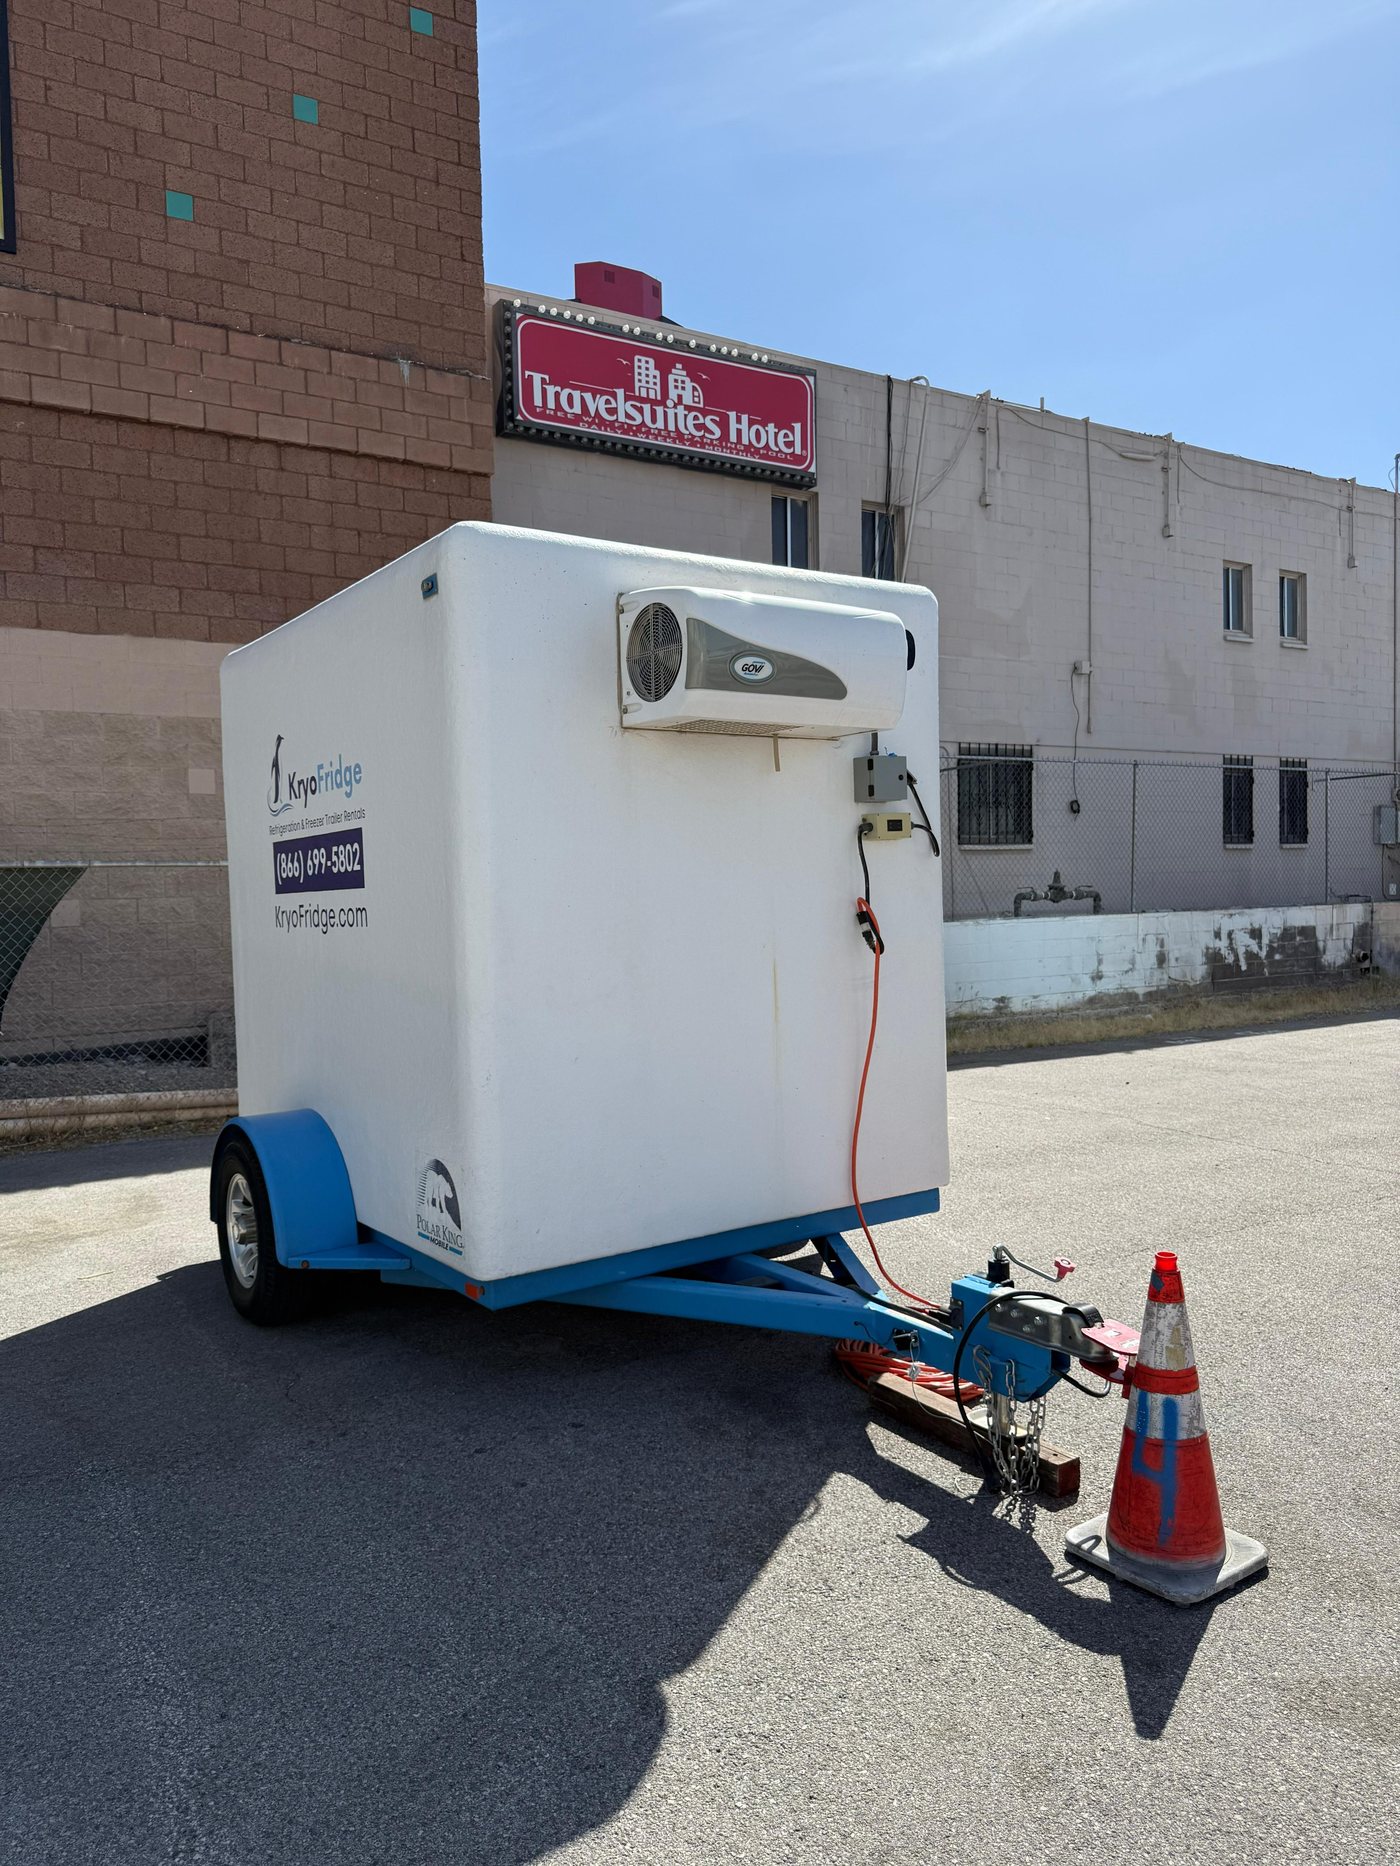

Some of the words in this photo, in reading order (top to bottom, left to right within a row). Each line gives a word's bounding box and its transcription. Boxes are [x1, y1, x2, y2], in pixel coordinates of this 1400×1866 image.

[525, 370, 721, 440] Travelsuites
[726, 411, 802, 456] Hotel
[536, 407, 576, 420] FREE
[642, 427, 678, 438] FREE
[684, 434, 746, 450] PARKING
[760, 449, 794, 460] POOL
[579, 422, 623, 434] DAILY
[637, 432, 690, 446] WEEKLY
[705, 445, 760, 459] MONTHLY
[288, 753, 362, 808] KryoFridge
[269, 821, 301, 837] Refrigeration
[305, 816, 325, 829] Freezer
[325, 812, 343, 825] Trailer
[344, 808, 366, 821] Rentals
[276, 850, 304, 885] (866)
[306, 842, 361, 876] 699-5802
[275, 904, 368, 935] KryoFridge.com
[429, 1235, 449, 1251] MOBILE
[1132, 1390, 1178, 1545] 4
